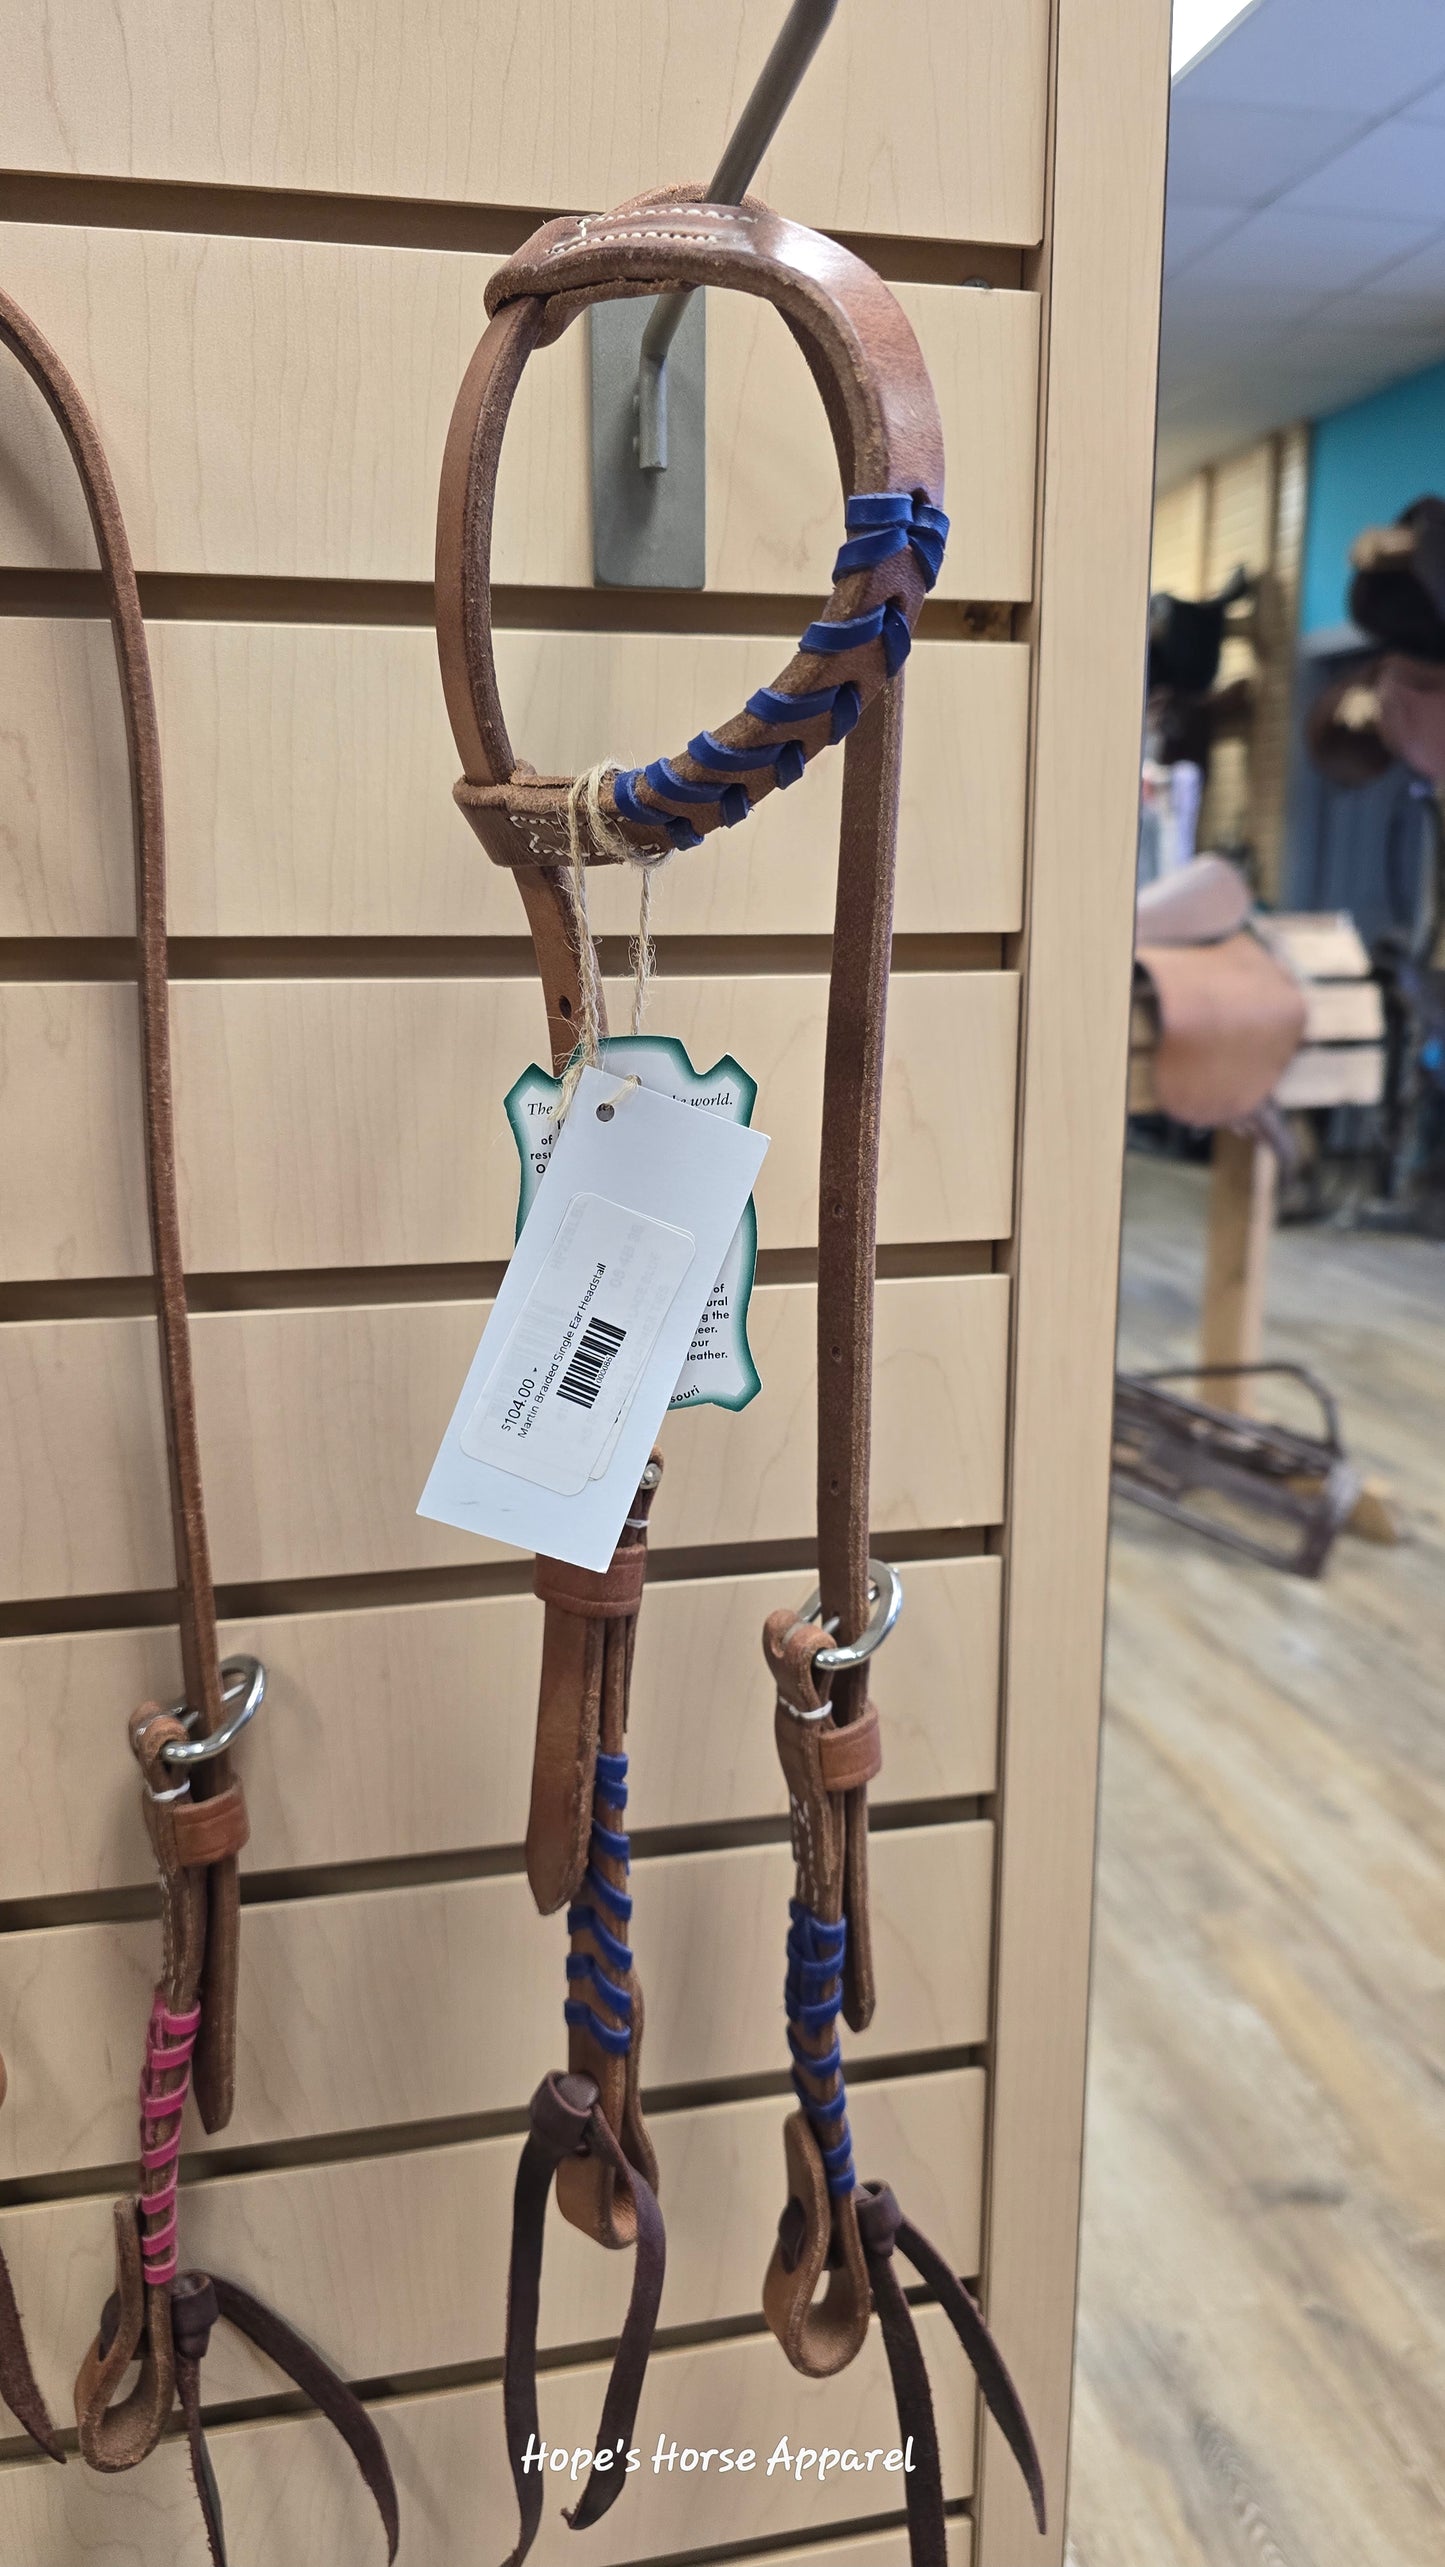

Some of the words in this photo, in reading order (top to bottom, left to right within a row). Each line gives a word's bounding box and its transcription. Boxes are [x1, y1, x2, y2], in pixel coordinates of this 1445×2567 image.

[528, 1103, 553, 1115] The
[690, 1093, 733, 1106] world.
[541, 1134, 553, 1145] of
[713, 1283, 724, 1293] of
[712, 1310, 729, 1320] the
[517, 1405, 540, 1439] Martin
[534, 1362, 559, 1404] Braided
[553, 1330, 575, 1362] Single
[568, 1310, 583, 1330] Ear
[577, 1262, 607, 1311] Headstall
[686, 1350, 728, 1361] leather.
[501, 1378, 535, 1432] $104.00
